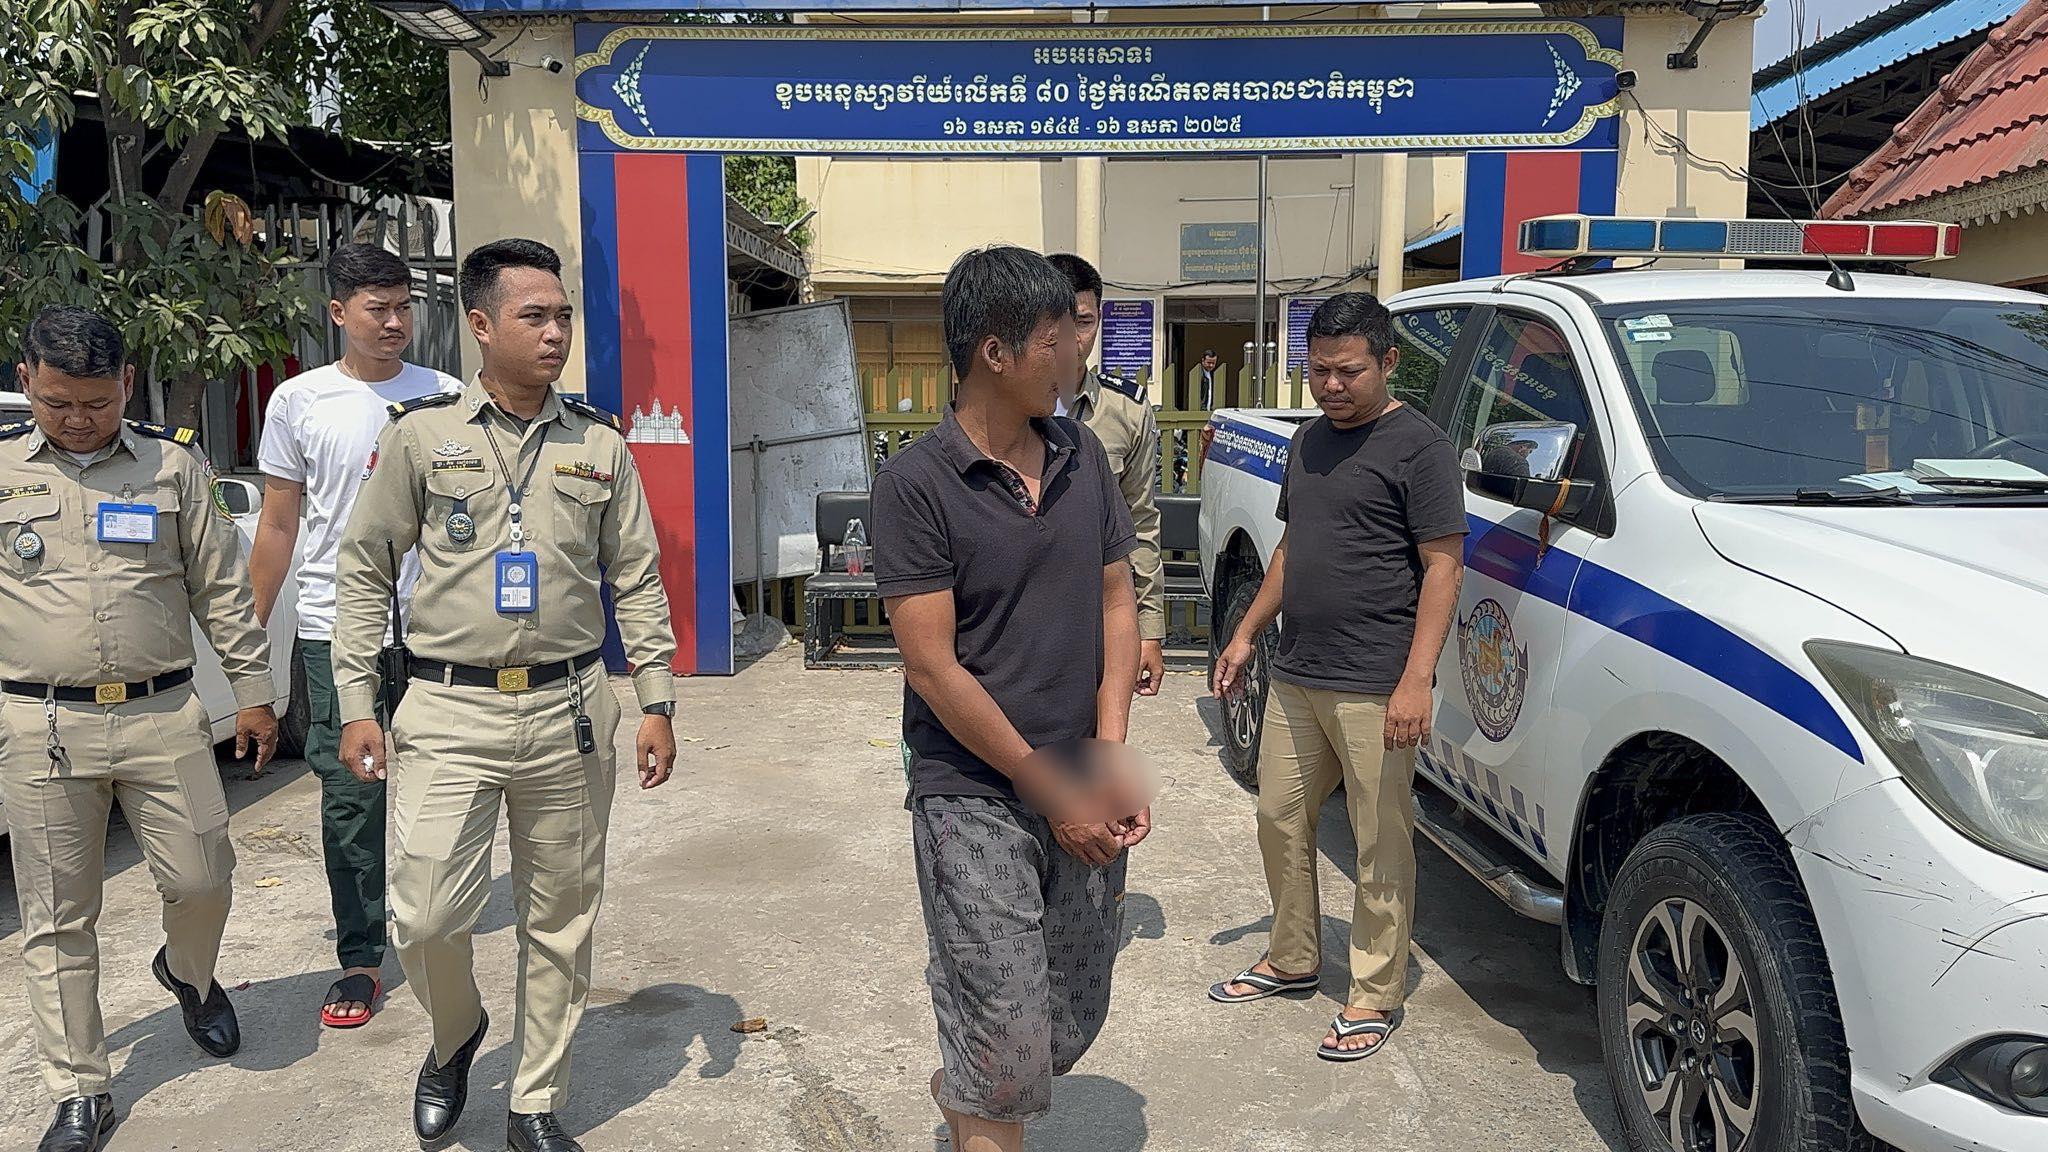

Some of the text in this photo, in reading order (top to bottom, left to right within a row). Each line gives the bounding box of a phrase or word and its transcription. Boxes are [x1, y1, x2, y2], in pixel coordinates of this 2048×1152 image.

[1034, 46, 1152, 65] អបអរសាទរ
[775, 71, 1415, 115] ខួបអនុស្សាវរីយ៍លើកទី ៨០ ថ្ងៃកំណើតនគរបាលជាតិកម្ពុជា
[943, 117, 968, 135] ១៦
[973, 120, 1025, 135] ឧសភា
[1030, 116, 1080, 135] ១៩៤៥
[1096, 116, 1121, 134] ១៦
[1127, 119, 1179, 134] ឧសភា
[1184, 115, 1242, 134] ២០២៥
